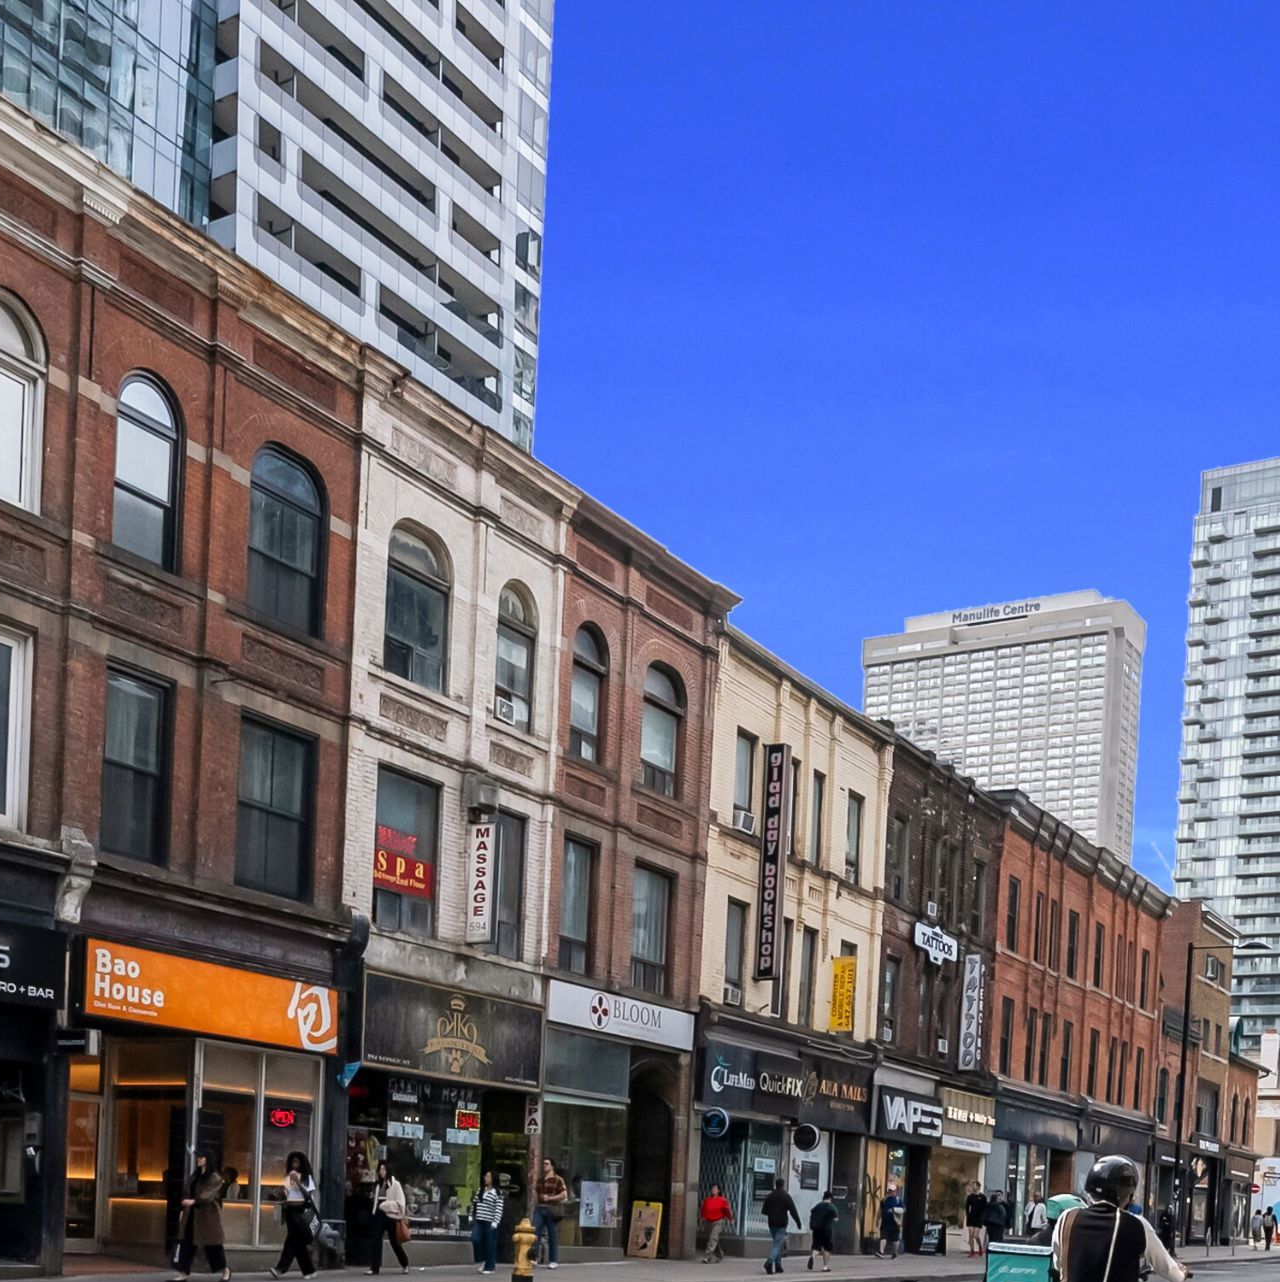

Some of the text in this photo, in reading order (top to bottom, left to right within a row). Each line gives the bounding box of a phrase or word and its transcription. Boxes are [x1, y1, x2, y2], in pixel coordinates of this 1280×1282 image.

[951, 601, 1041, 624] Manulife Centre
[377, 850, 425, 879] Spa
[472, 827, 490, 917] MASSAGE
[759, 751, 782, 971] glad day bookshop
[921, 932, 953, 957] TATTOOS
[95, 948, 141, 978] Bao
[27, 985, 55, 1000] BAR
[94, 972, 165, 1008] House
[613, 999, 662, 1028] BLOOM
[961, 957, 979, 1068] TATTOO
[527, 1096, 539, 1127] SPA
[882, 1094, 943, 1138] VAPES
